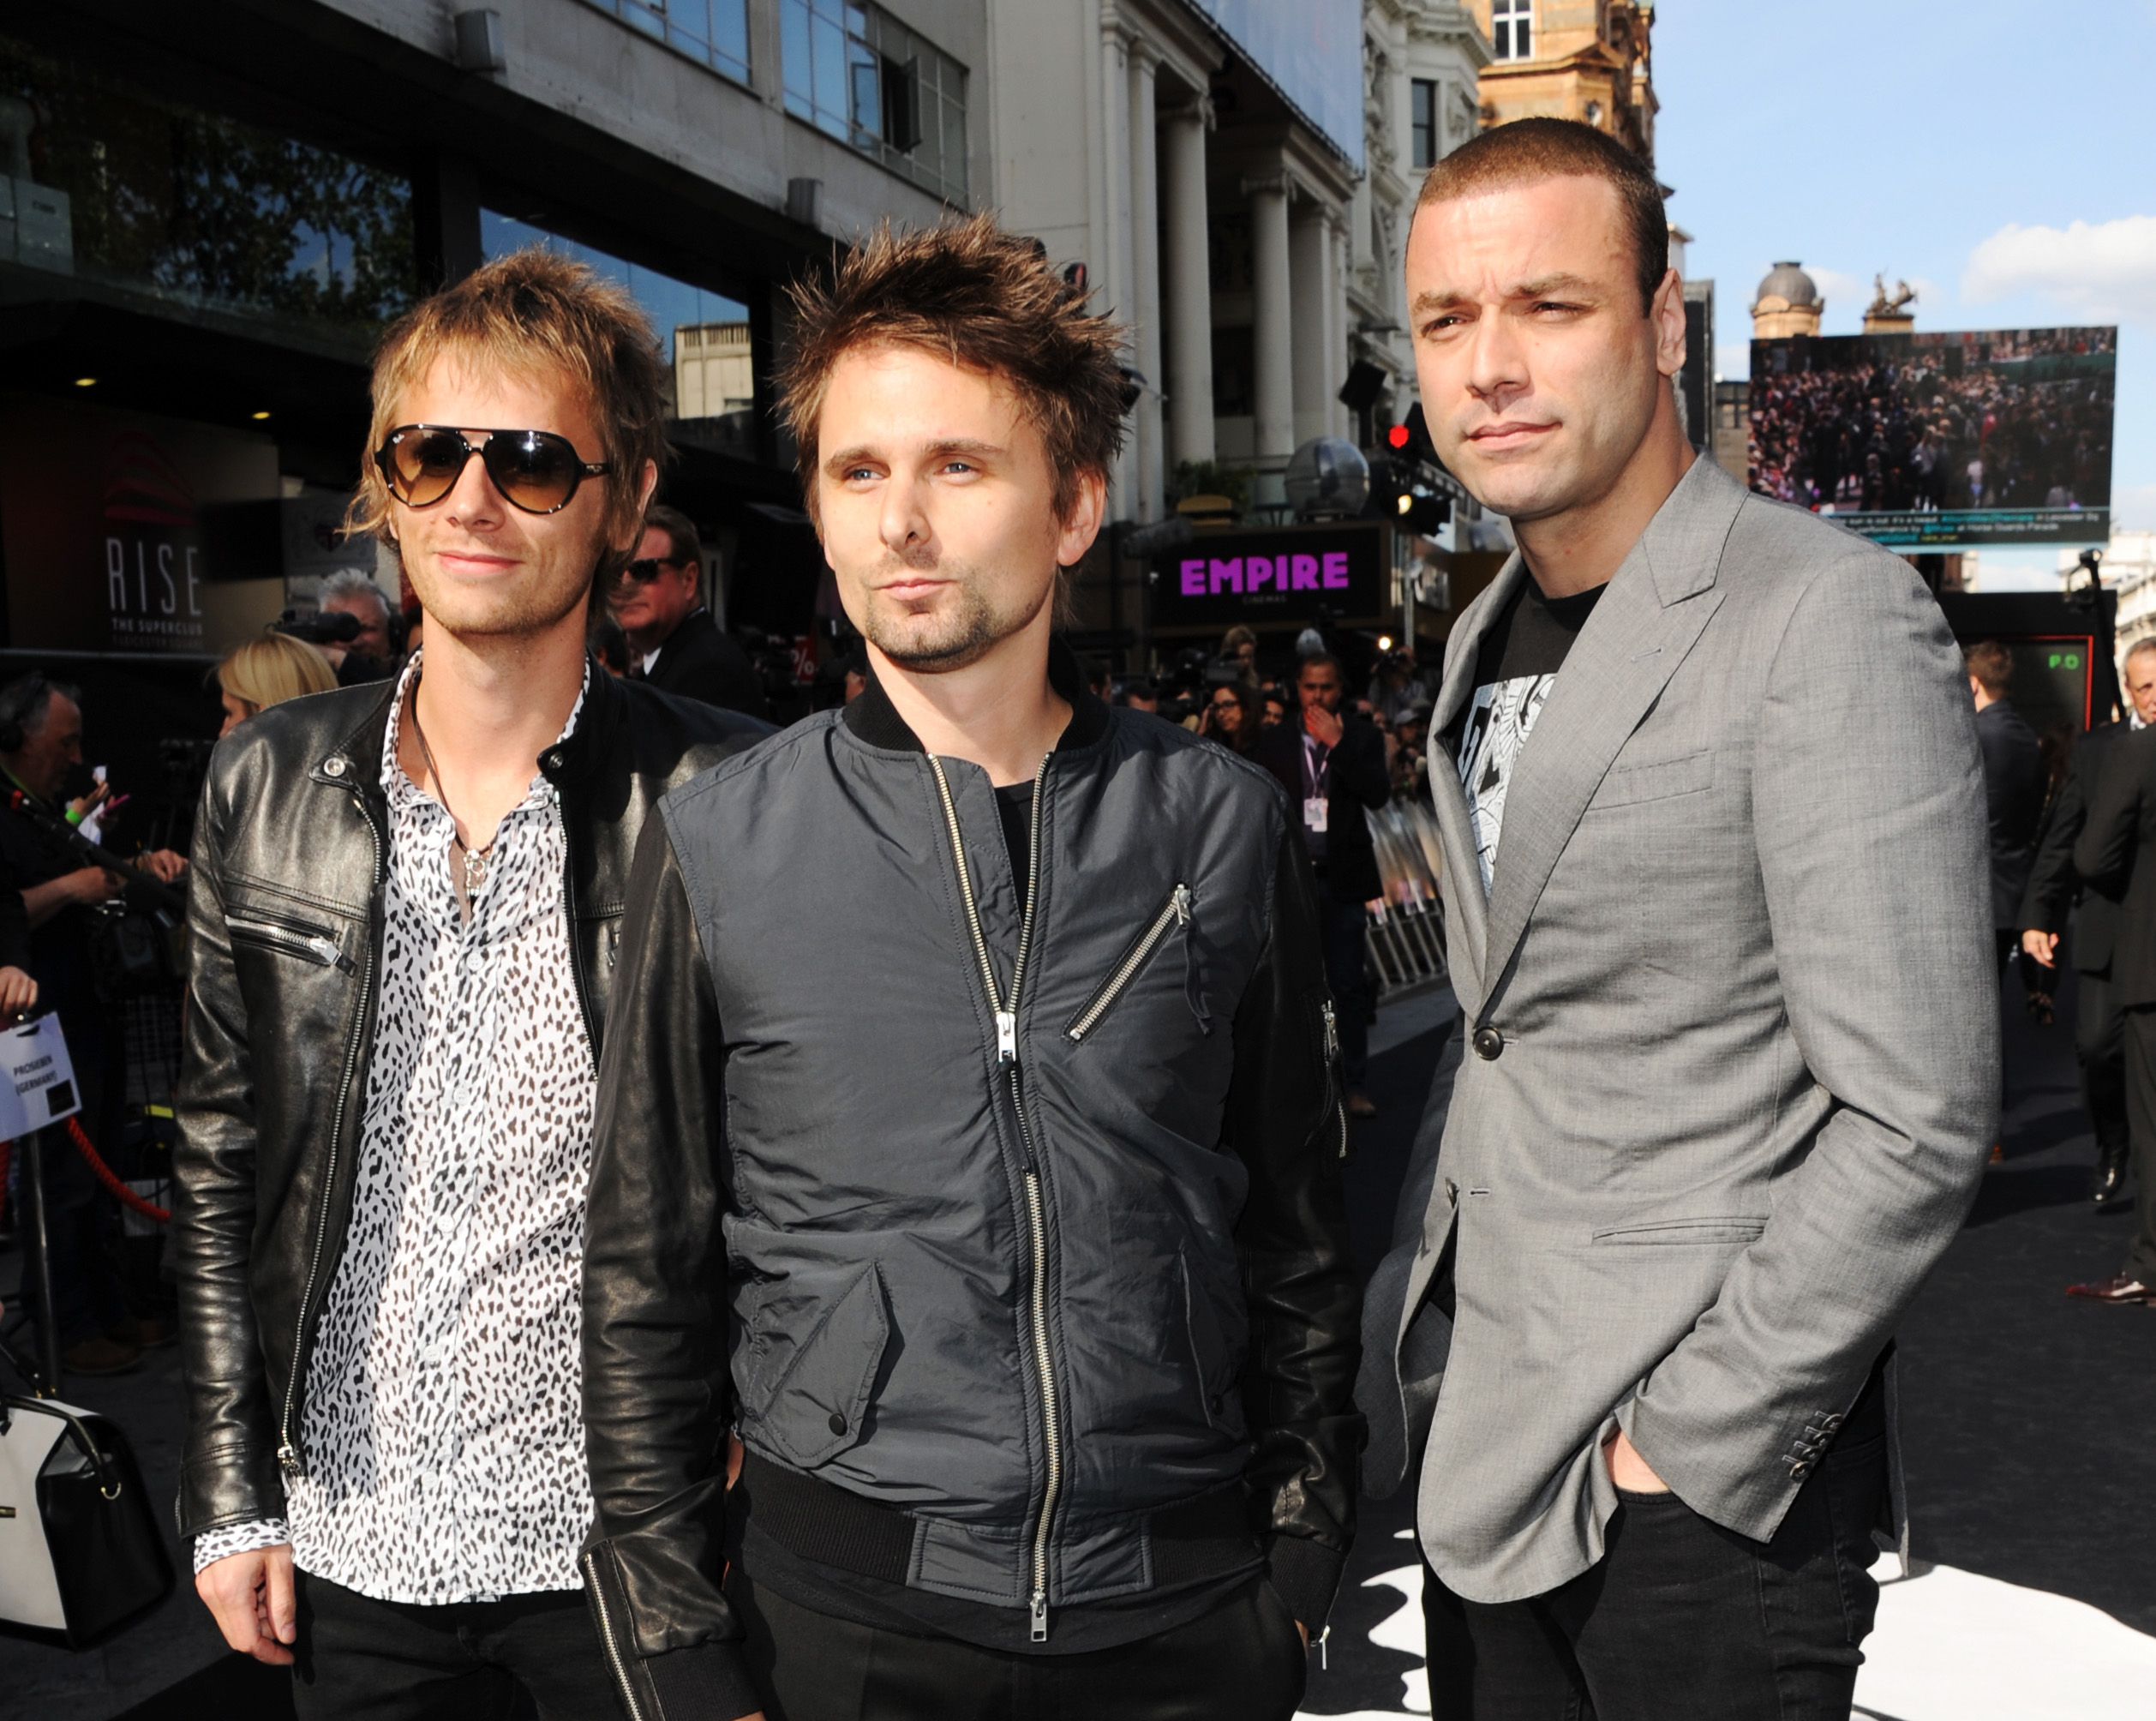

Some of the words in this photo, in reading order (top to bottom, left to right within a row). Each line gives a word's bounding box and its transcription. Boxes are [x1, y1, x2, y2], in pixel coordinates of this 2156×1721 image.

[105, 537, 201, 616] RISE
[1180, 552, 1349, 596] EMPIRE
[111, 617, 135, 633] THE
[138, 619, 203, 636] SUPERCLUB
